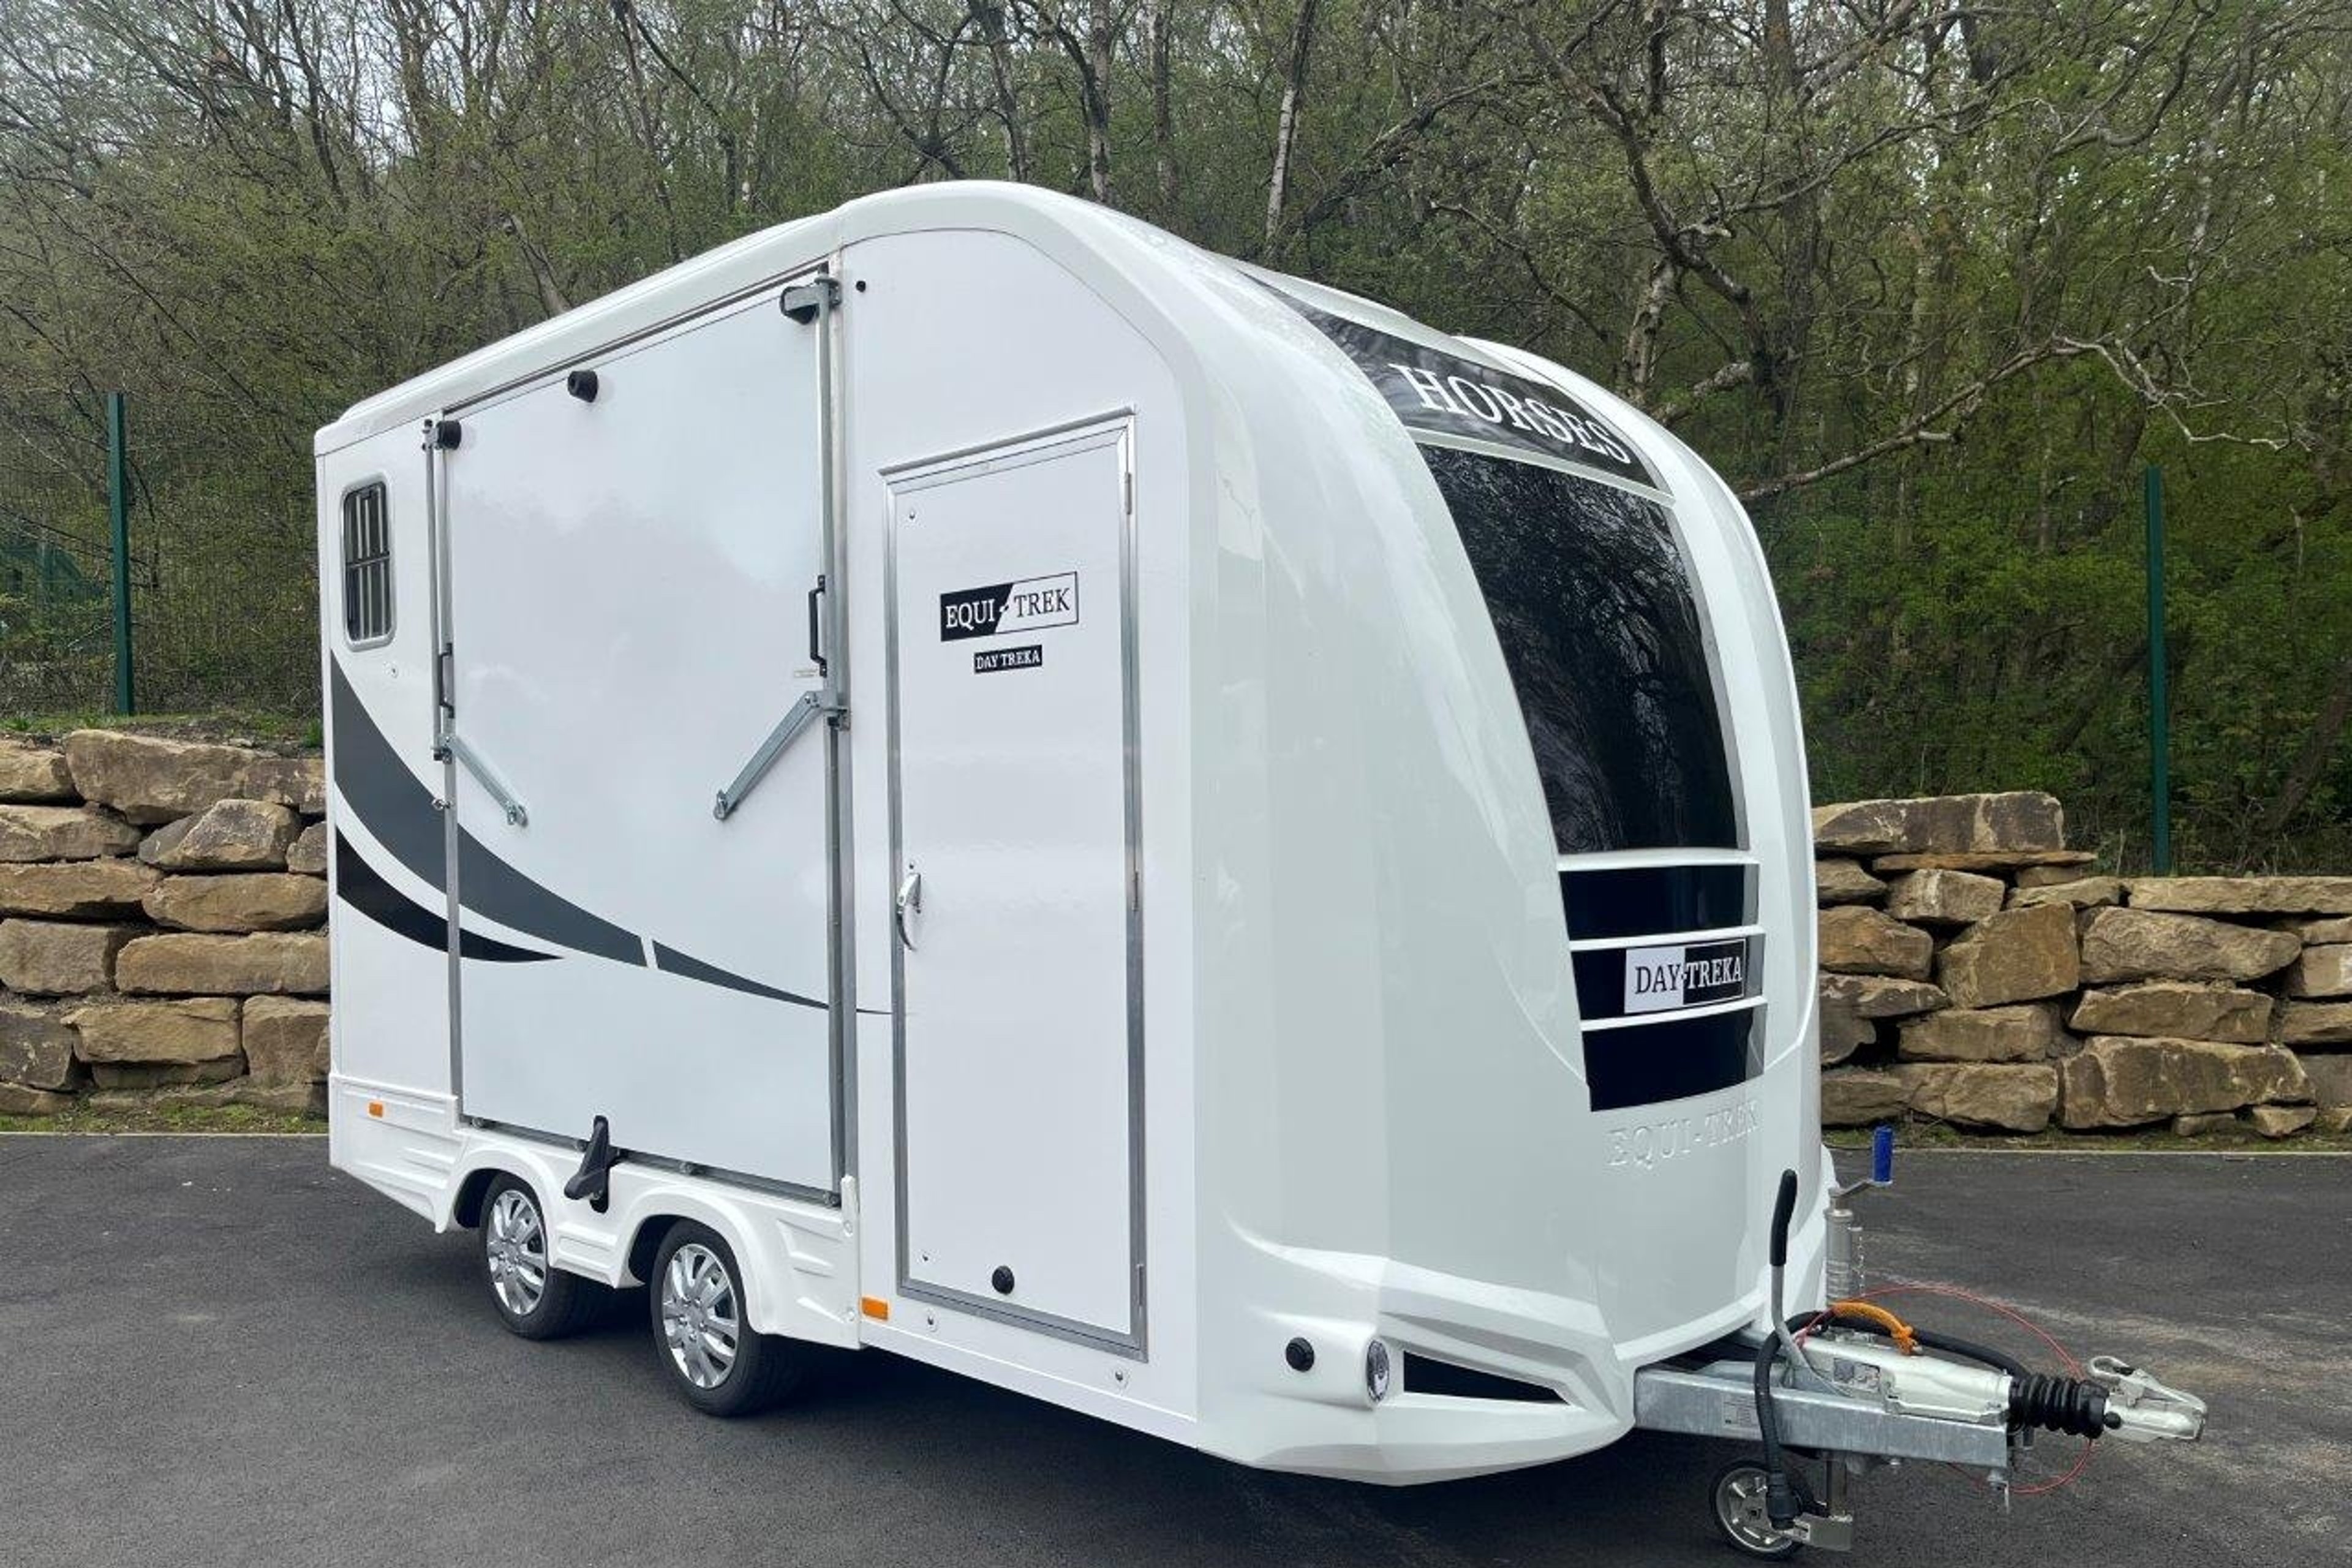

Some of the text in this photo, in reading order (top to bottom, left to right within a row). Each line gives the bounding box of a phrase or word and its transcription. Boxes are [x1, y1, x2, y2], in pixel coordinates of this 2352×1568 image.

[1389, 363, 1630, 464] HORSES
[976, 649, 1040, 669] DAY TREKA
